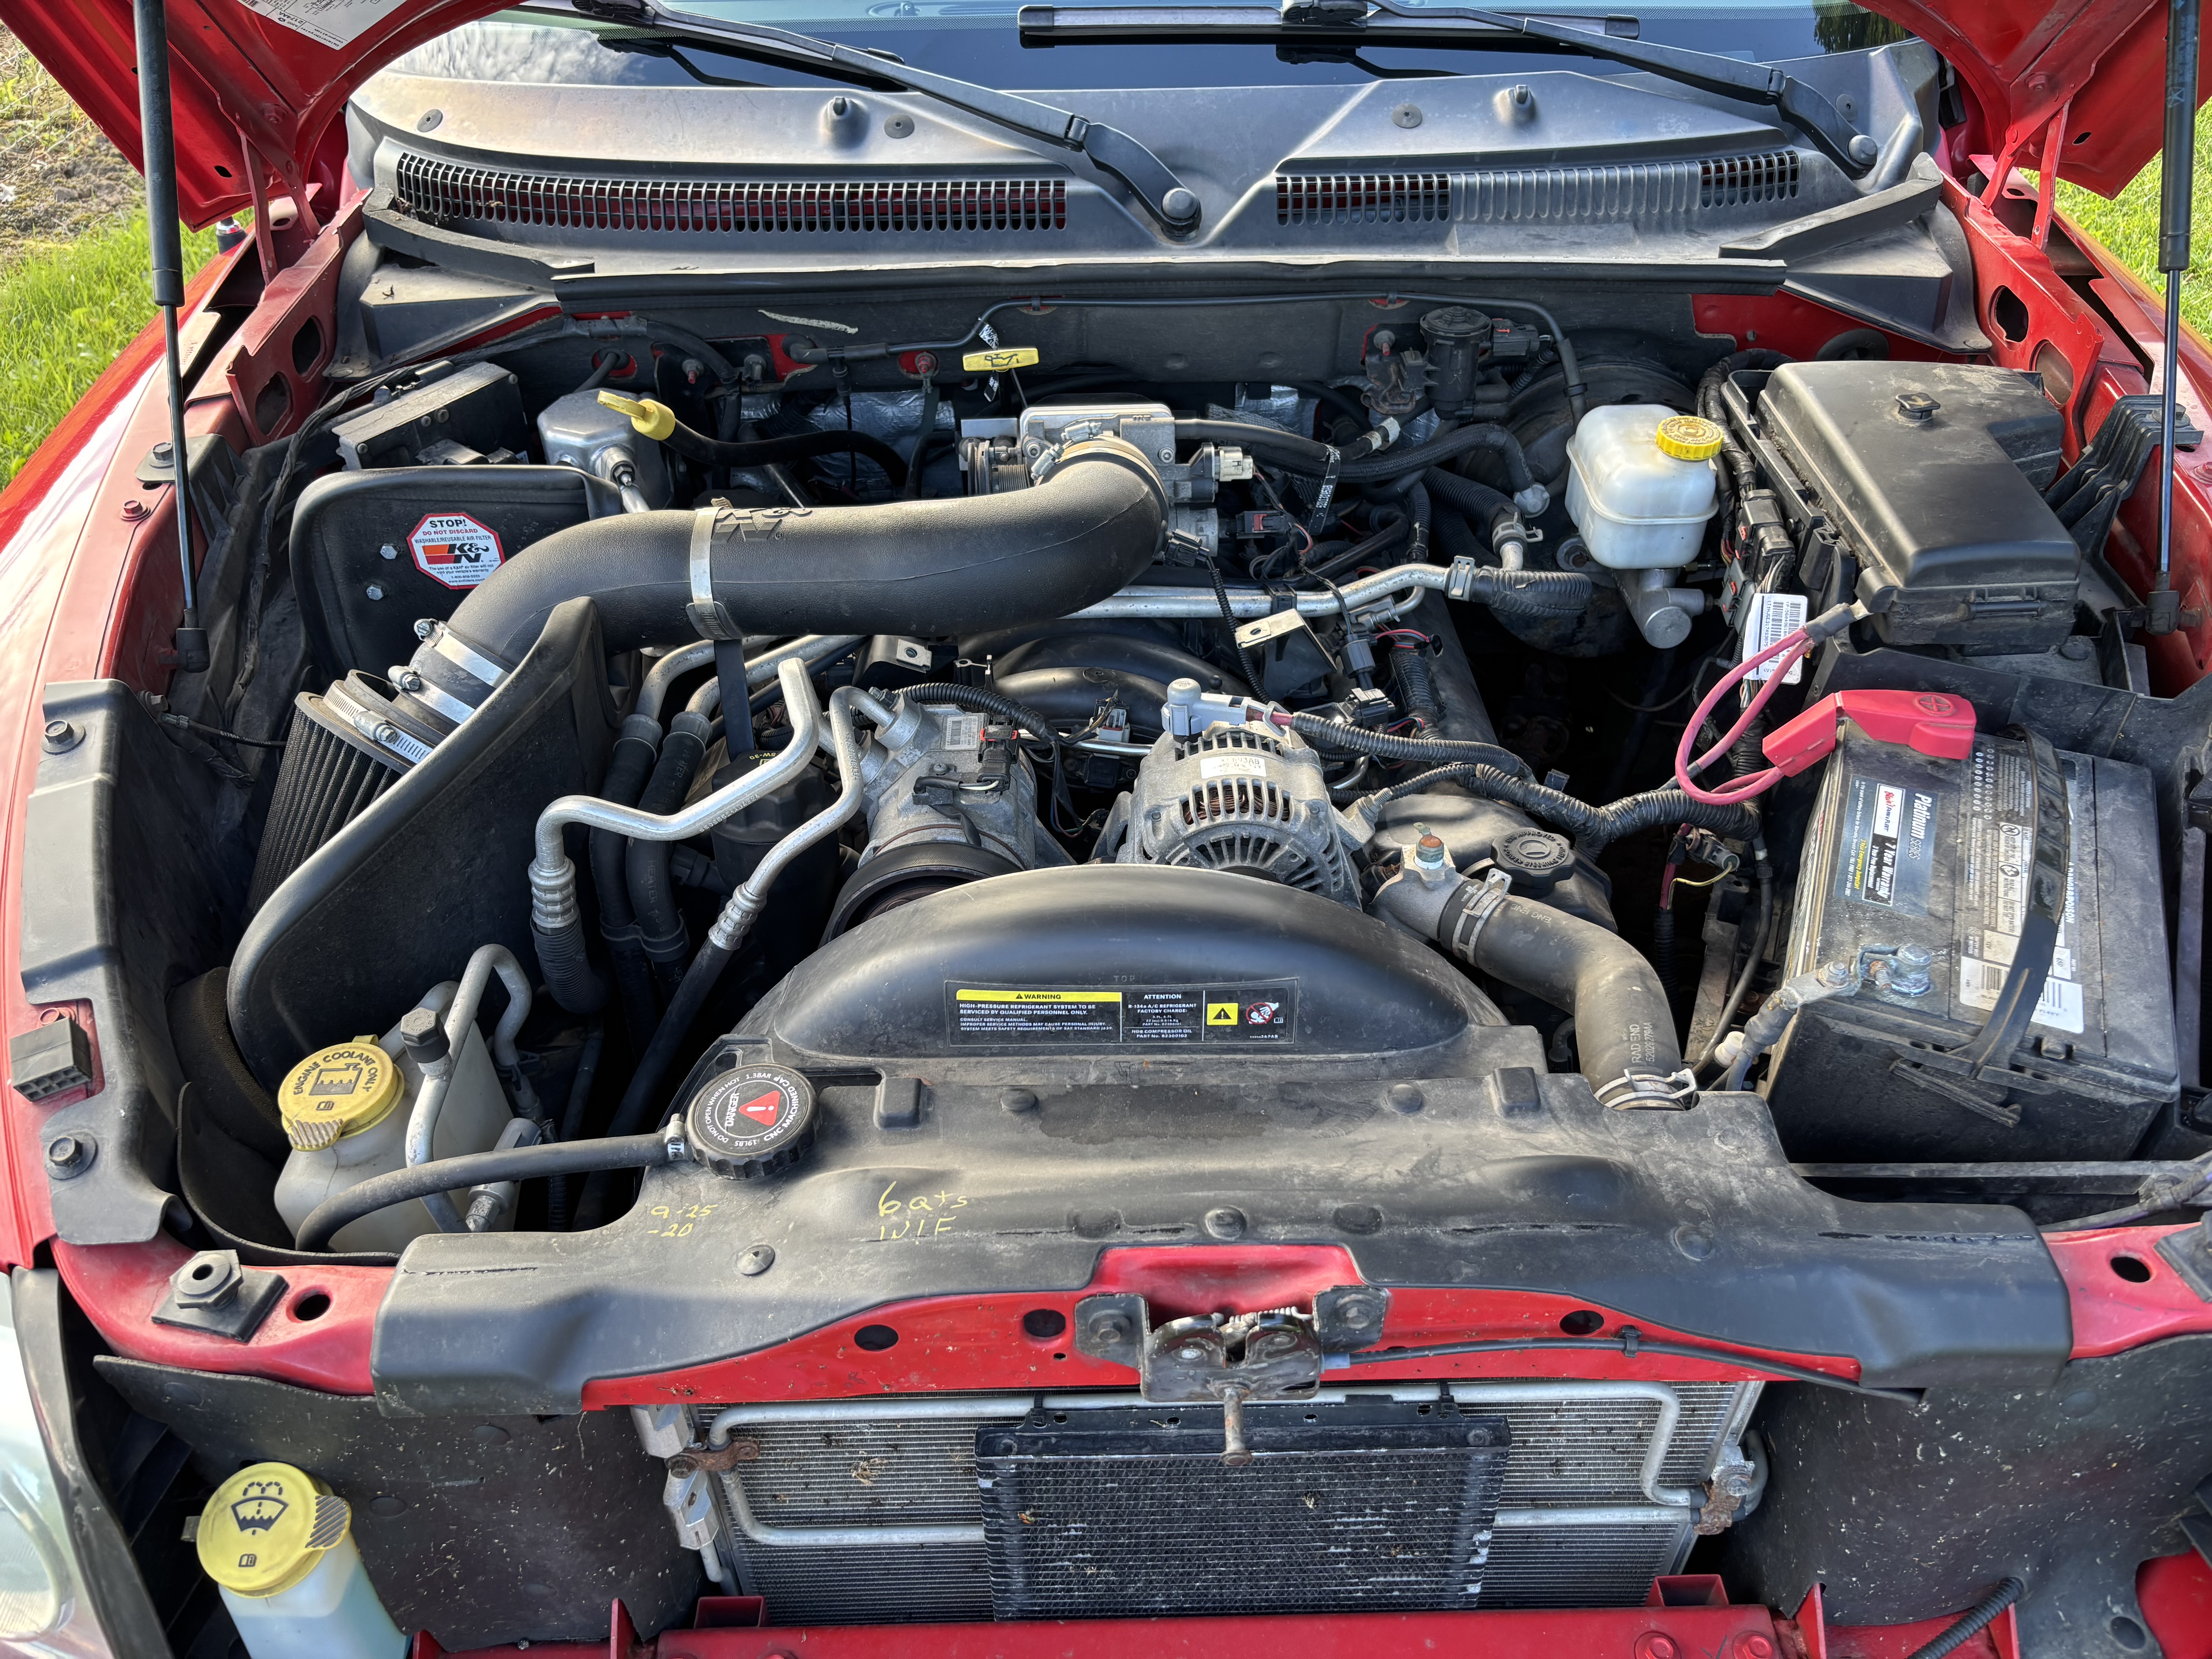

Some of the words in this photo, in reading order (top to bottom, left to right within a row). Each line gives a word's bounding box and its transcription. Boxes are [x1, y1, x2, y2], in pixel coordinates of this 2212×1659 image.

[429, 520, 466, 528] STOP!
[1910, 793, 1932, 839] Platinum
[1517, 830, 1556, 841] APPROVED
[1503, 848, 1523, 864] POWER
[1524, 858, 1559, 867] STEERING
[1882, 849, 1894, 864] Year
[1908, 838, 1922, 860] SERIES
[1855, 850, 1865, 870] Emergency
[647, 859, 658, 903] HEATER
[1853, 870, 1862, 889] Jumpstart
[1867, 865, 1877, 888] Replacement
[1876, 866, 1893, 898] Warranty
[1531, 910, 1552, 923] ENG
[1630, 1024, 1640, 1041] END
[1631, 1043, 1642, 1063] RAD
[293, 1061, 321, 1095] ENGINE
[323, 1051, 376, 1066] COOLANT
[362, 1067, 378, 1092] ONLY
[726, 1077, 741, 1088] HOT
[774, 1074, 790, 1086] CAP
[708, 1087, 725, 1107] WHEN
[725, 1092, 740, 1127] DANGER
[783, 1087, 799, 1130] MACHINED
[707, 1123, 718, 1137] NOT
[764, 1127, 784, 1141] CNC
[879, 1181, 897, 1216] 6
